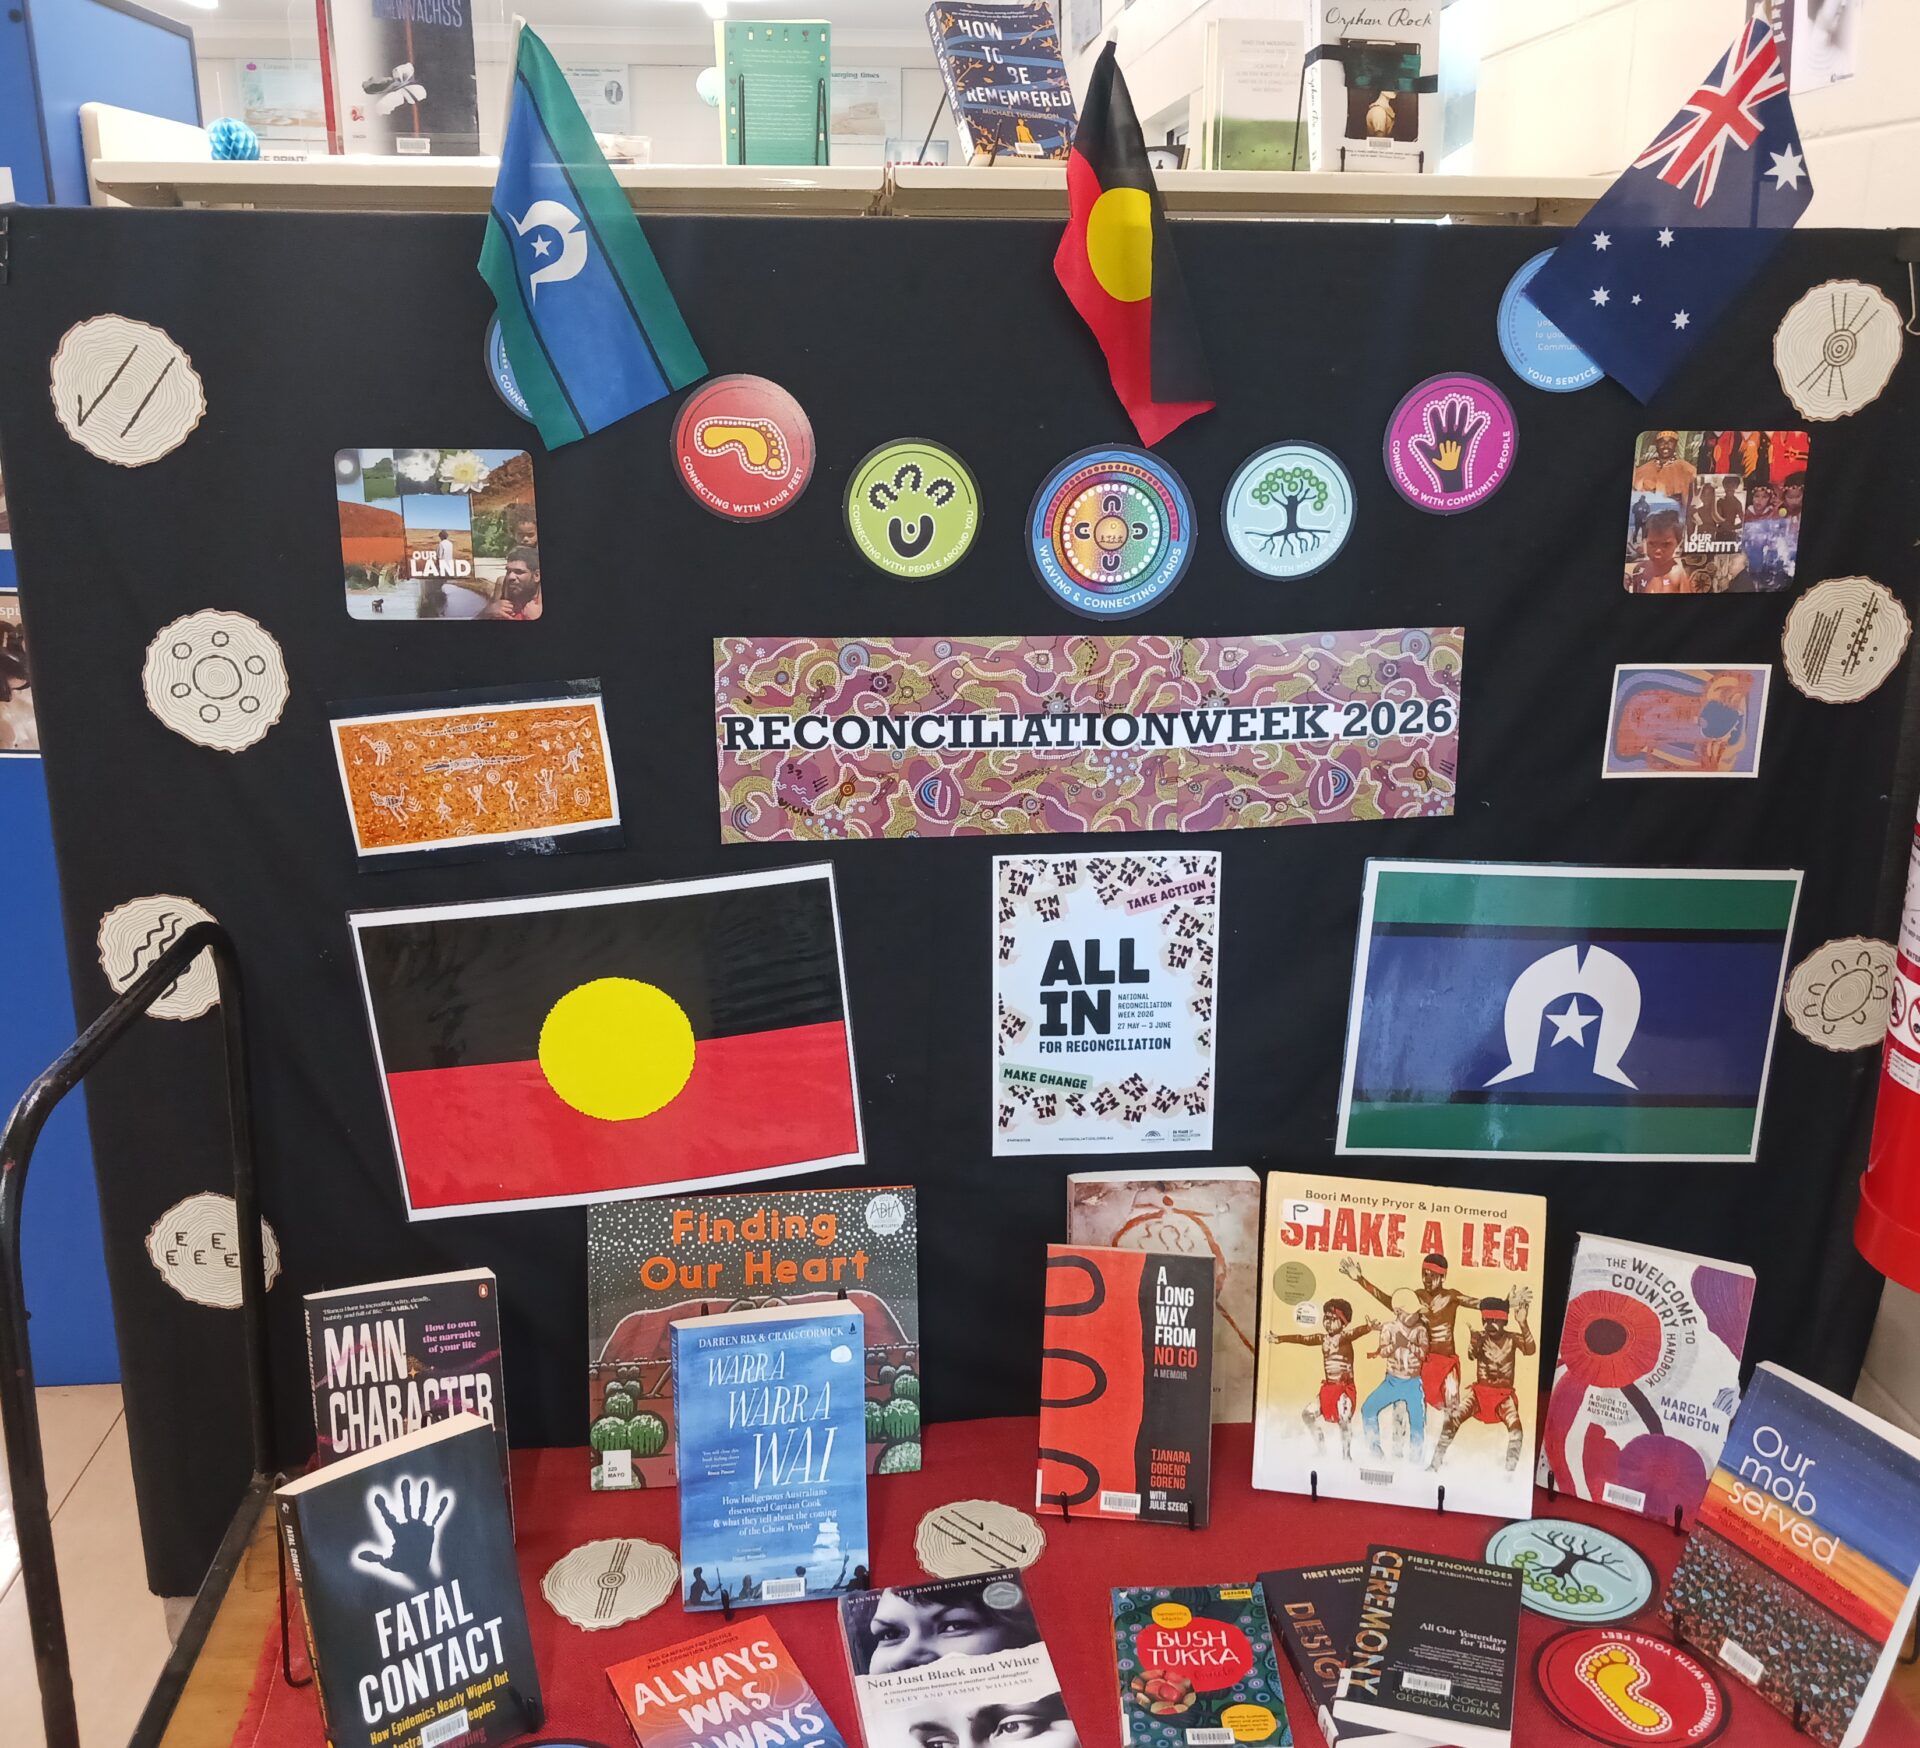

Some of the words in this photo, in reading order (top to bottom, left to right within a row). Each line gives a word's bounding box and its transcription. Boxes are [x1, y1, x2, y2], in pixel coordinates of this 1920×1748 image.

[957, 19, 1003, 41] HOW
[1325, 7, 1383, 37] Orphan
[1388, 8, 1432, 28] Rock
[981, 45, 1004, 64] TO
[1007, 66, 1031, 85] BE
[966, 87, 1072, 107] REMEMBERED
[982, 108, 1015, 118] MICHAEL
[1016, 110, 1060, 120] THOMPSON
[1537, 343, 1578, 351] Commun
[1527, 367, 1553, 384] YOUR
[1556, 366, 1598, 385] SERVICE
[1392, 440, 1419, 496] CONNECTING
[1420, 492, 1444, 506] WITH
[1446, 470, 1500, 506] COMMUNITY
[1497, 430, 1511, 470] PEOPLE
[683, 455, 730, 510] CONNECTING
[733, 503, 761, 514] WITH
[763, 487, 790, 509] YOUR
[787, 466, 804, 491] FEET
[1684, 540, 1743, 553] IDENTITY
[1690, 533, 1712, 543] OUR
[412, 550, 438, 561] OUR
[883, 556, 906, 572] WITH
[410, 559, 472, 577] LAND
[1039, 544, 1072, 595] WEAVING
[1084, 584, 1157, 608] CONNECTING
[1157, 547, 1181, 584] CARDS
[1342, 700, 1454, 738] 2026
[1126, 893, 1158, 910] TAKE
[1160, 879, 1207, 902] ACTION
[1040, 938, 1150, 986] ALL
[1040, 989, 1111, 1036] IN
[1118, 1001, 1172, 1009] RECONCILIATION
[1117, 1022, 1125, 1030] 27
[1155, 1021, 1172, 1029] JUNE
[1039, 1040, 1062, 1053] FOR
[1066, 1037, 1171, 1053] RECONCILIATION
[1003, 1068, 1037, 1082] MAKE
[1039, 1073, 1088, 1090] CHANGE
[1305, 1189, 1337, 1202] Boori
[1340, 1193, 1378, 1208] Monty
[1382, 1198, 1415, 1213] Pryor
[1418, 1201, 1428, 1211] &
[1431, 1202, 1450, 1214] Jan
[1454, 1204, 1508, 1220] Ormerod
[671, 1208, 837, 1246] Finding
[1280, 1207, 1407, 1259] SHAKE
[1420, 1220, 1445, 1256] A
[1461, 1222, 1530, 1272] LEG
[640, 1255, 723, 1291] Our
[744, 1250, 870, 1286] Heart
[1157, 1266, 1168, 1286] A
[1156, 1286, 1194, 1307] LONG
[1606, 1257, 1628, 1269] THE
[1632, 1257, 1698, 1327] WELCOME
[1684, 1330, 1696, 1345] TO
[1155, 1306, 1188, 1327] WAY
[422, 1334, 437, 1344] the
[439, 1330, 481, 1342] narrative
[425, 1323, 445, 1333] How
[699, 1336, 741, 1348] DARREN
[768, 1331, 799, 1342] CRAIG
[800, 1326, 844, 1338] CORMICK
[1154, 1326, 1196, 1348] FROM
[1611, 1273, 1679, 1328] COUNTRY
[1645, 1332, 1676, 1388] HANDBOOK
[324, 1318, 408, 1390] MAIN
[1154, 1346, 1174, 1367] NO
[1178, 1349, 1198, 1369] GO
[708, 1350, 785, 1387] WARRA
[1160, 1369, 1188, 1381] MEMOIR
[329, 1372, 496, 1454] CHARACTER
[729, 1381, 832, 1430] WARRA
[1587, 1407, 1624, 1421] AUSTRALIA
[1588, 1400, 1629, 1416] INDIGENOUS
[1660, 1396, 1708, 1419] MARCIA
[1663, 1409, 1720, 1435] LANGTON
[753, 1426, 839, 1490] WAI
[1152, 1449, 1191, 1464] TJANARA
[1752, 1425, 1817, 1479] Our
[1151, 1463, 1186, 1477] GORENG
[1150, 1476, 1186, 1490] GORENG
[1738, 1454, 1818, 1518] mob
[723, 1495, 741, 1505] How
[741, 1492, 784, 1506] Indigenous
[785, 1488, 828, 1499] Australians
[1150, 1490, 1167, 1500] WITH
[722, 1517, 740, 1527] what
[773, 1513, 794, 1523] about
[809, 1508, 837, 1520] coming
[728, 1503, 769, 1515] discovered
[770, 1502, 800, 1515] Captain
[801, 1499, 821, 1509] Cook
[1149, 1500, 1166, 1511] JULIE
[1167, 1502, 1189, 1513] SZEGO
[762, 1524, 784, 1534] Ghost
[787, 1522, 812, 1534] People
[1727, 1481, 1841, 1565] served
[285, 1524, 296, 1546] FATAL
[1302, 1570, 1328, 1580] FIRST
[1330, 1566, 1364, 1576] KNOW
[1408, 1555, 1434, 1566] FIRST
[1437, 1561, 1513, 1580] KNOWLEDGES
[917, 1585, 942, 1594] DAVID
[944, 1578, 983, 1589] UNAIPON
[985, 1573, 1014, 1583] AWARD
[848, 1594, 881, 1604] WINNER
[374, 1578, 474, 1659] FATAL
[1350, 1550, 1404, 1696] CEREMONY
[1156, 1630, 1227, 1648] BUSH
[1419, 1622, 1435, 1633] All
[1436, 1625, 1456, 1637] Our
[1459, 1629, 1508, 1646] Yesterdays
[1601, 1631, 1632, 1642] FEET
[1636, 1634, 1671, 1656] YOUR
[1147, 1648, 1240, 1666] TUKKA
[1460, 1638, 1475, 1648] for
[1477, 1640, 1508, 1654] Today
[358, 1616, 504, 1725] CONTACT
[634, 1640, 778, 1716] ALWAYS
[867, 1678, 892, 1691] Not
[896, 1674, 925, 1686] Just
[928, 1667, 965, 1681] Black
[969, 1662, 995, 1674] and
[999, 1656, 1040, 1670] White
[1674, 1654, 1705, 1681] WITH
[985, 1678, 1032, 1691] WILLIAMS
[370, 1727, 390, 1745] How
[391, 1706, 436, 1737] Epidemics
[436, 1691, 465, 1715] Nearly
[466, 1678, 493, 1699] Wiped
[494, 1670, 510, 1688] Out
[467, 1699, 496, 1721] eoples
[678, 1681, 771, 1735] WAS
[1396, 1692, 1449, 1709] GEORGIA
[1452, 1703, 1500, 1719] CURRAN
[1450, 1695, 1489, 1708] ENOCH
[1688, 1682, 1717, 1738] CONNECTING
